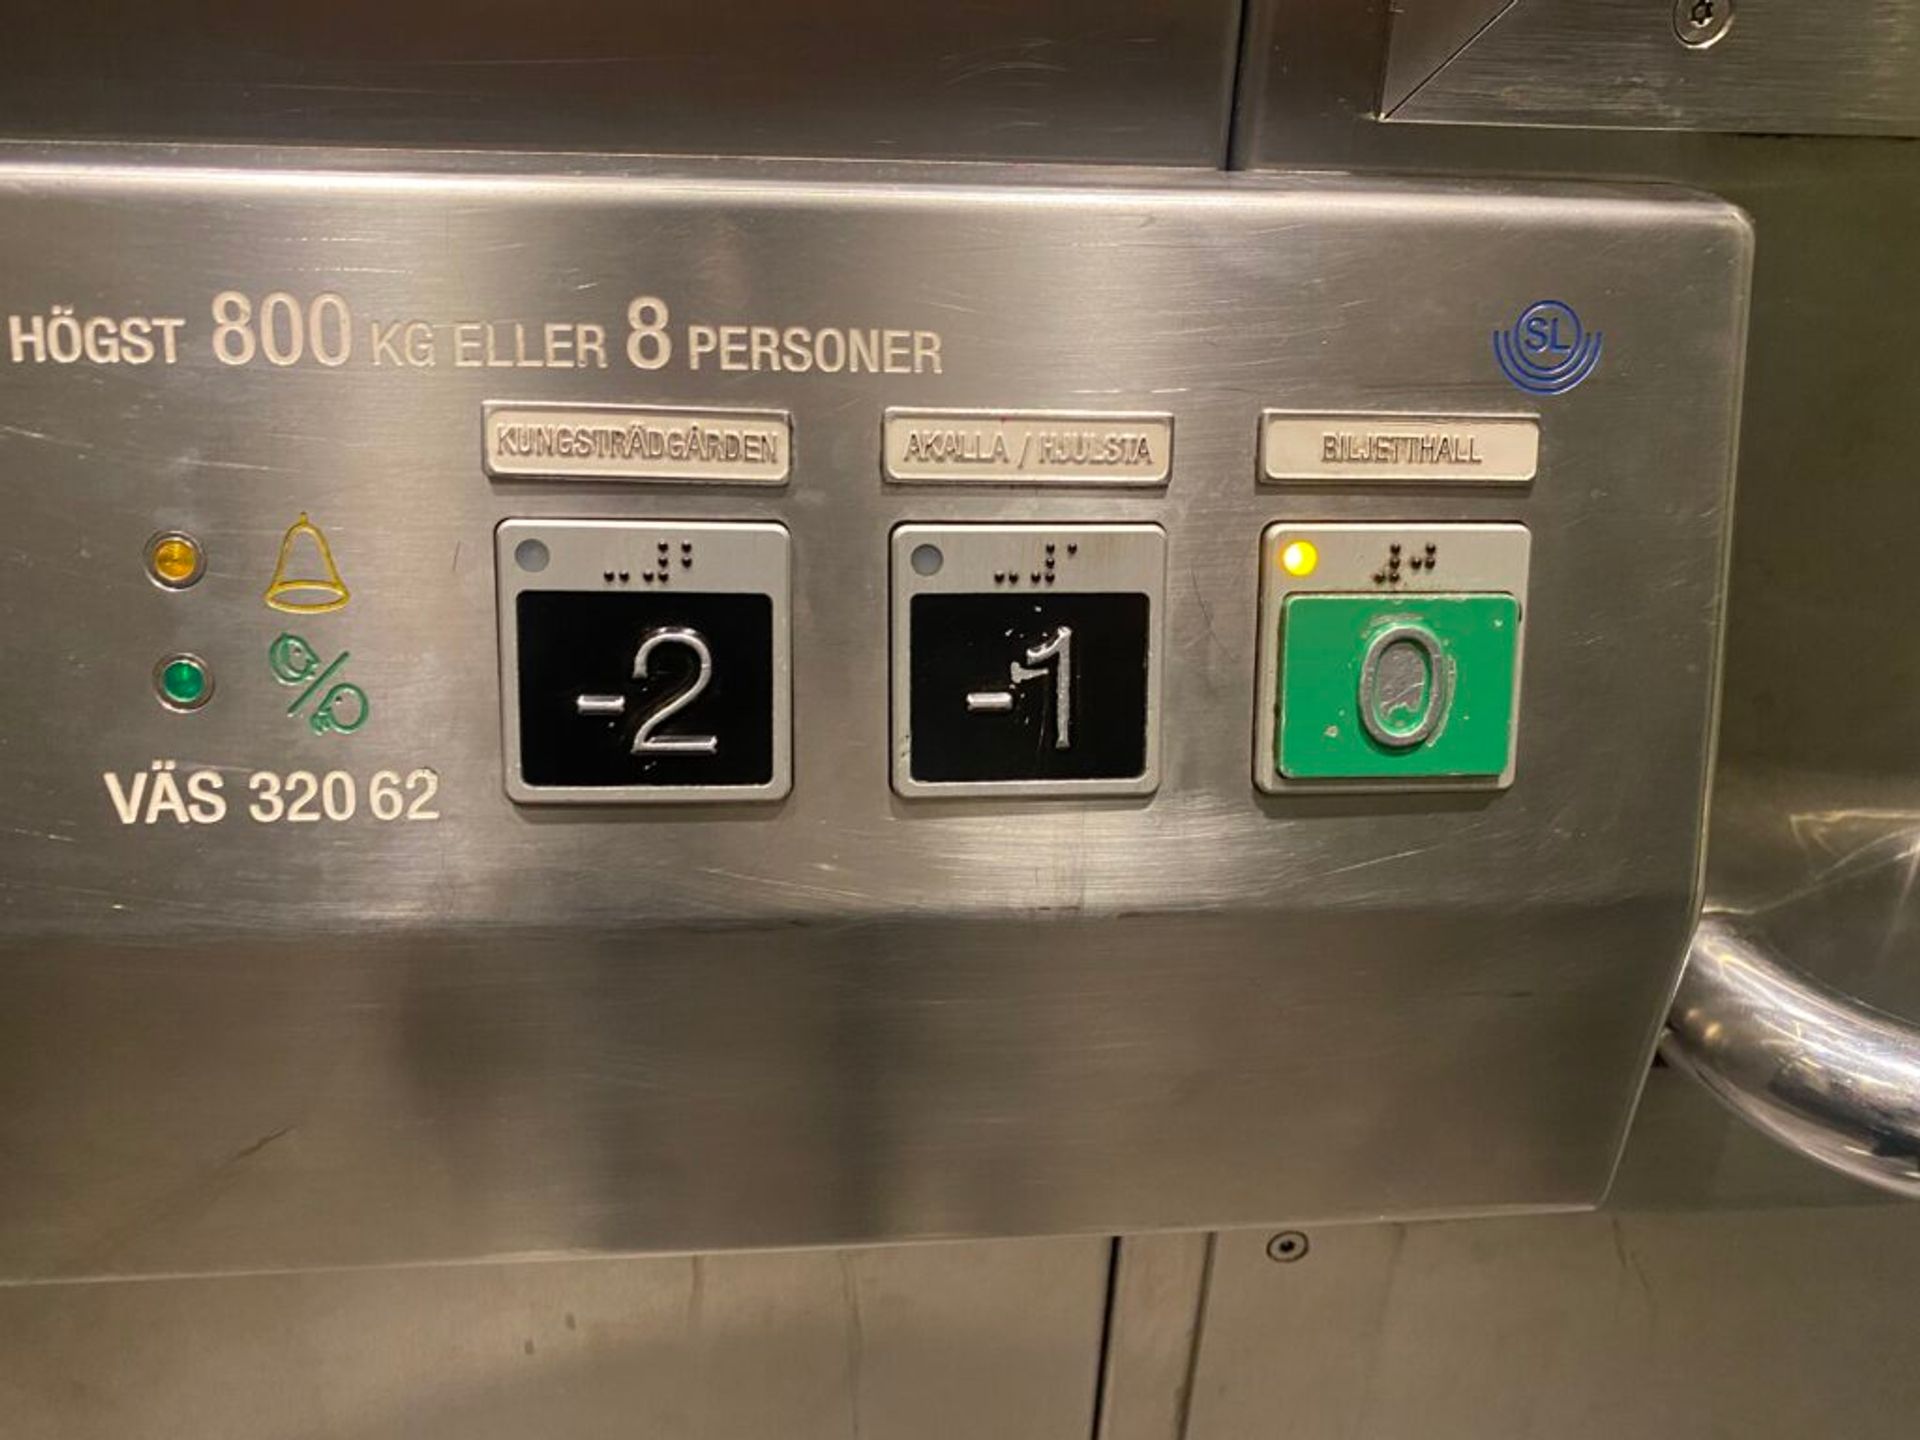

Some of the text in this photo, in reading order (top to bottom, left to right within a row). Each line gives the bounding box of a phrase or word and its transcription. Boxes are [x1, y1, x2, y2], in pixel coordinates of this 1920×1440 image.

[8, 290, 943, 374] HÖGST 800 KG ELLER 8 PERSONER
[1523, 317, 1572, 352] SL
[496, 420, 779, 465] KUNGSTRÄDGÅRDEN
[903, 430, 1009, 464] AKALLA
[1038, 431, 1154, 466] HJULSTA
[1321, 431, 1483, 465] BILJETTHALL
[576, 625, 718, 755] -2
[966, 625, 1073, 749] -1
[1358, 622, 1445, 750] 0
[104, 760, 441, 825] VÄS 320 62
